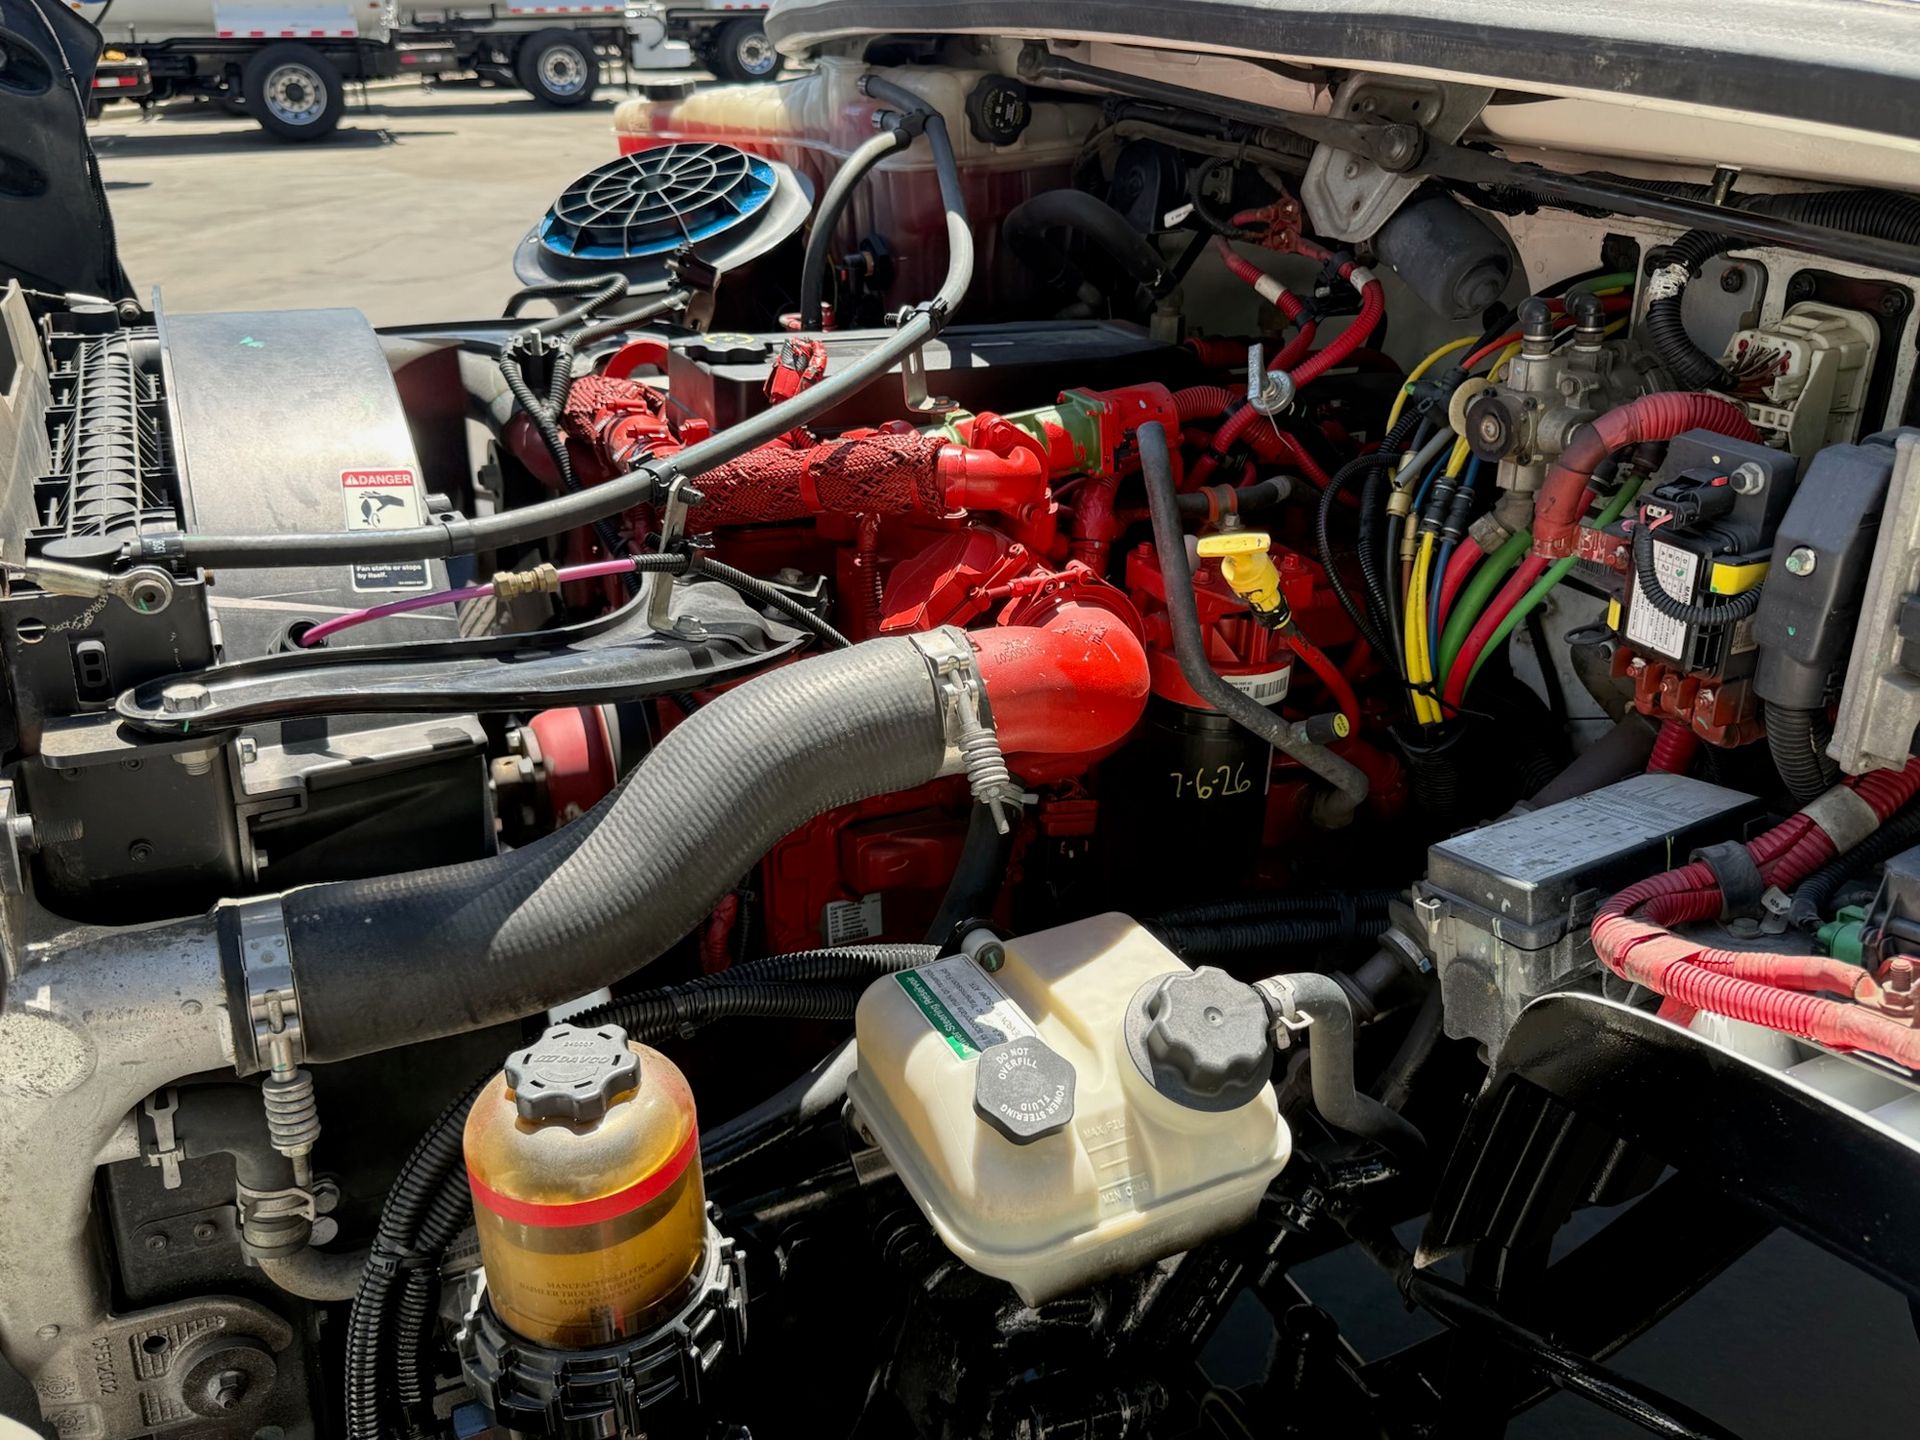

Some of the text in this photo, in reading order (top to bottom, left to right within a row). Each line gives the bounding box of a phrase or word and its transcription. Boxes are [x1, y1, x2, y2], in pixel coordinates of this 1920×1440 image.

[359, 474, 411, 485] DANGER
[1170, 762, 1251, 799] 7-6-26
[906, 976, 970, 1052] Power Steering Reservoir
[996, 1048, 1028, 1064] DO NOT
[998, 1058, 1037, 1079] OVERFILL
[1000, 1085, 1064, 1121] POWER STEERING
[1020, 1095, 1050, 1111] FLUID
[1102, 1191, 1122, 1203] MIN
